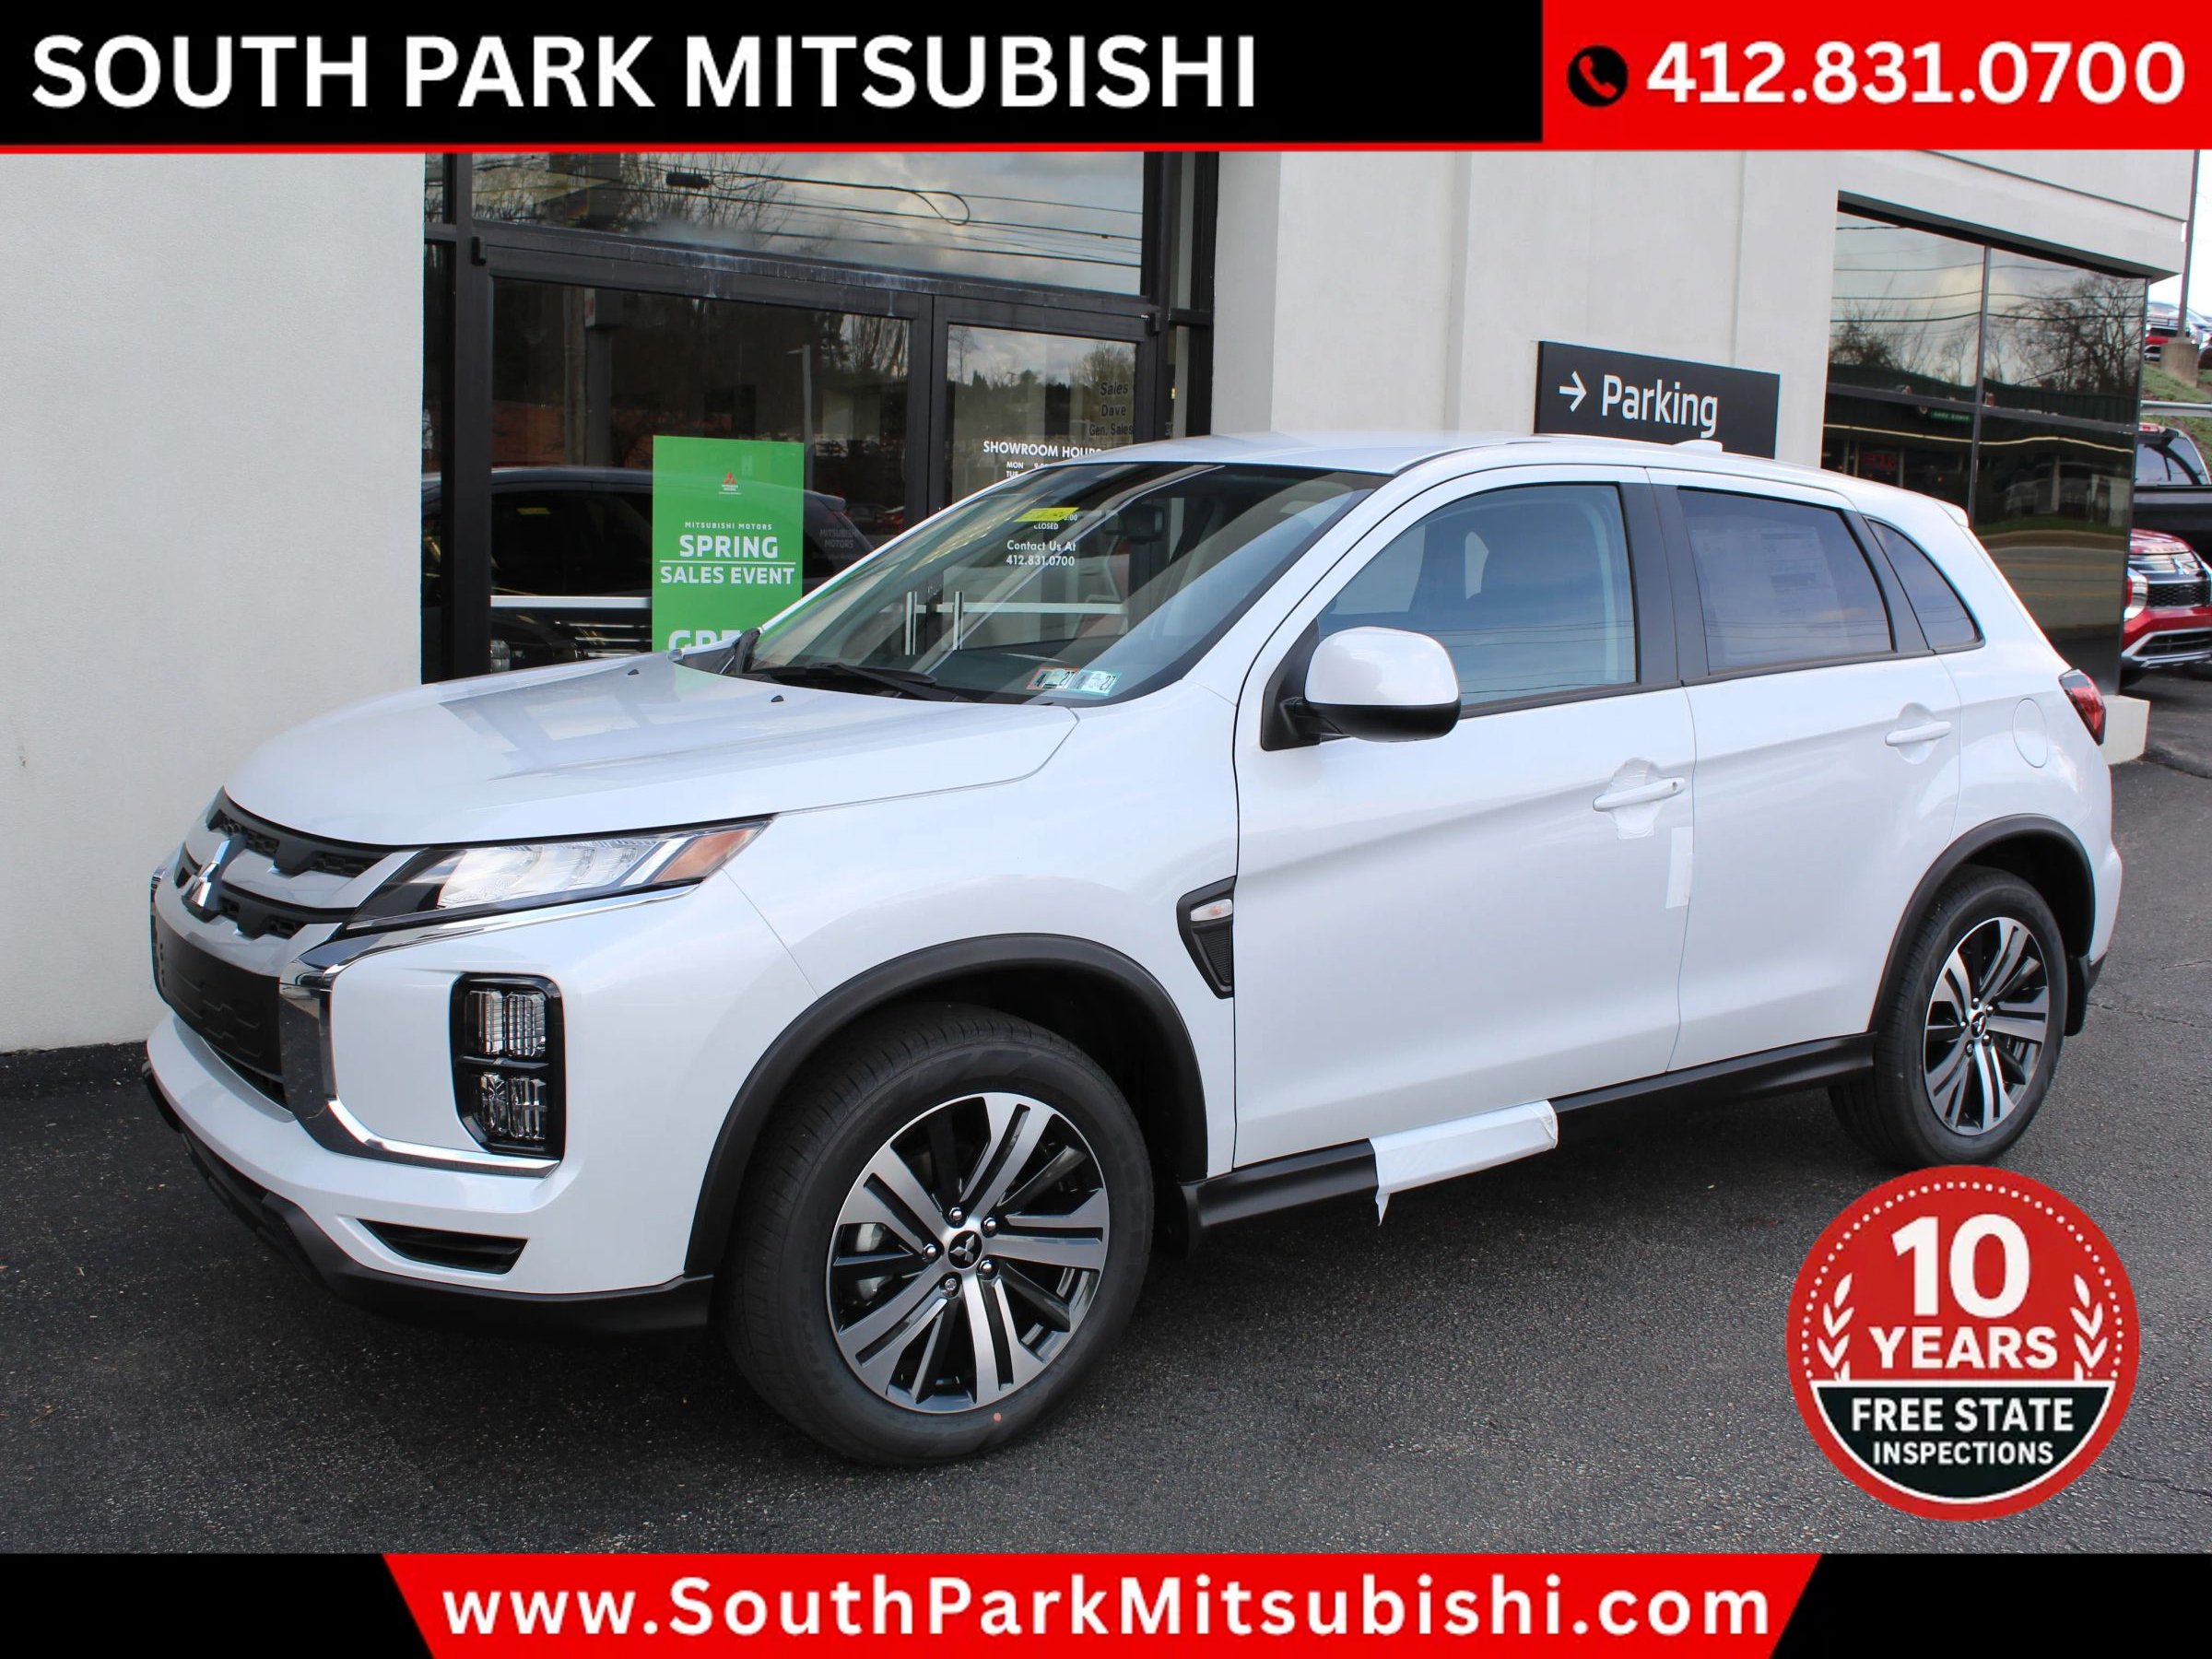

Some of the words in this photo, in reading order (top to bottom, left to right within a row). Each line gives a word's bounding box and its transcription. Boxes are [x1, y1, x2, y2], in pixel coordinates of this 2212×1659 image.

[1100, 382, 1129, 396] Sales
[1101, 405, 1127, 418] Dave
[1601, 373, 1719, 439] Parking
[1089, 423, 1109, 436] Gen.
[1111, 423, 1134, 436] Sales
[982, 441, 1059, 458] SHOWROOM
[1006, 462, 1024, 470] MON
[685, 522, 735, 530] MITSUBISHI
[738, 523, 772, 531] MOTORS
[678, 535, 779, 559] SPRING
[1006, 539, 1046, 551] Contact
[1049, 539, 1062, 551] Us
[1065, 540, 1077, 551] At
[1006, 555, 1076, 567] 412.831.0700
[660, 566, 724, 584] SALES
[731, 567, 795, 585] EVENT
